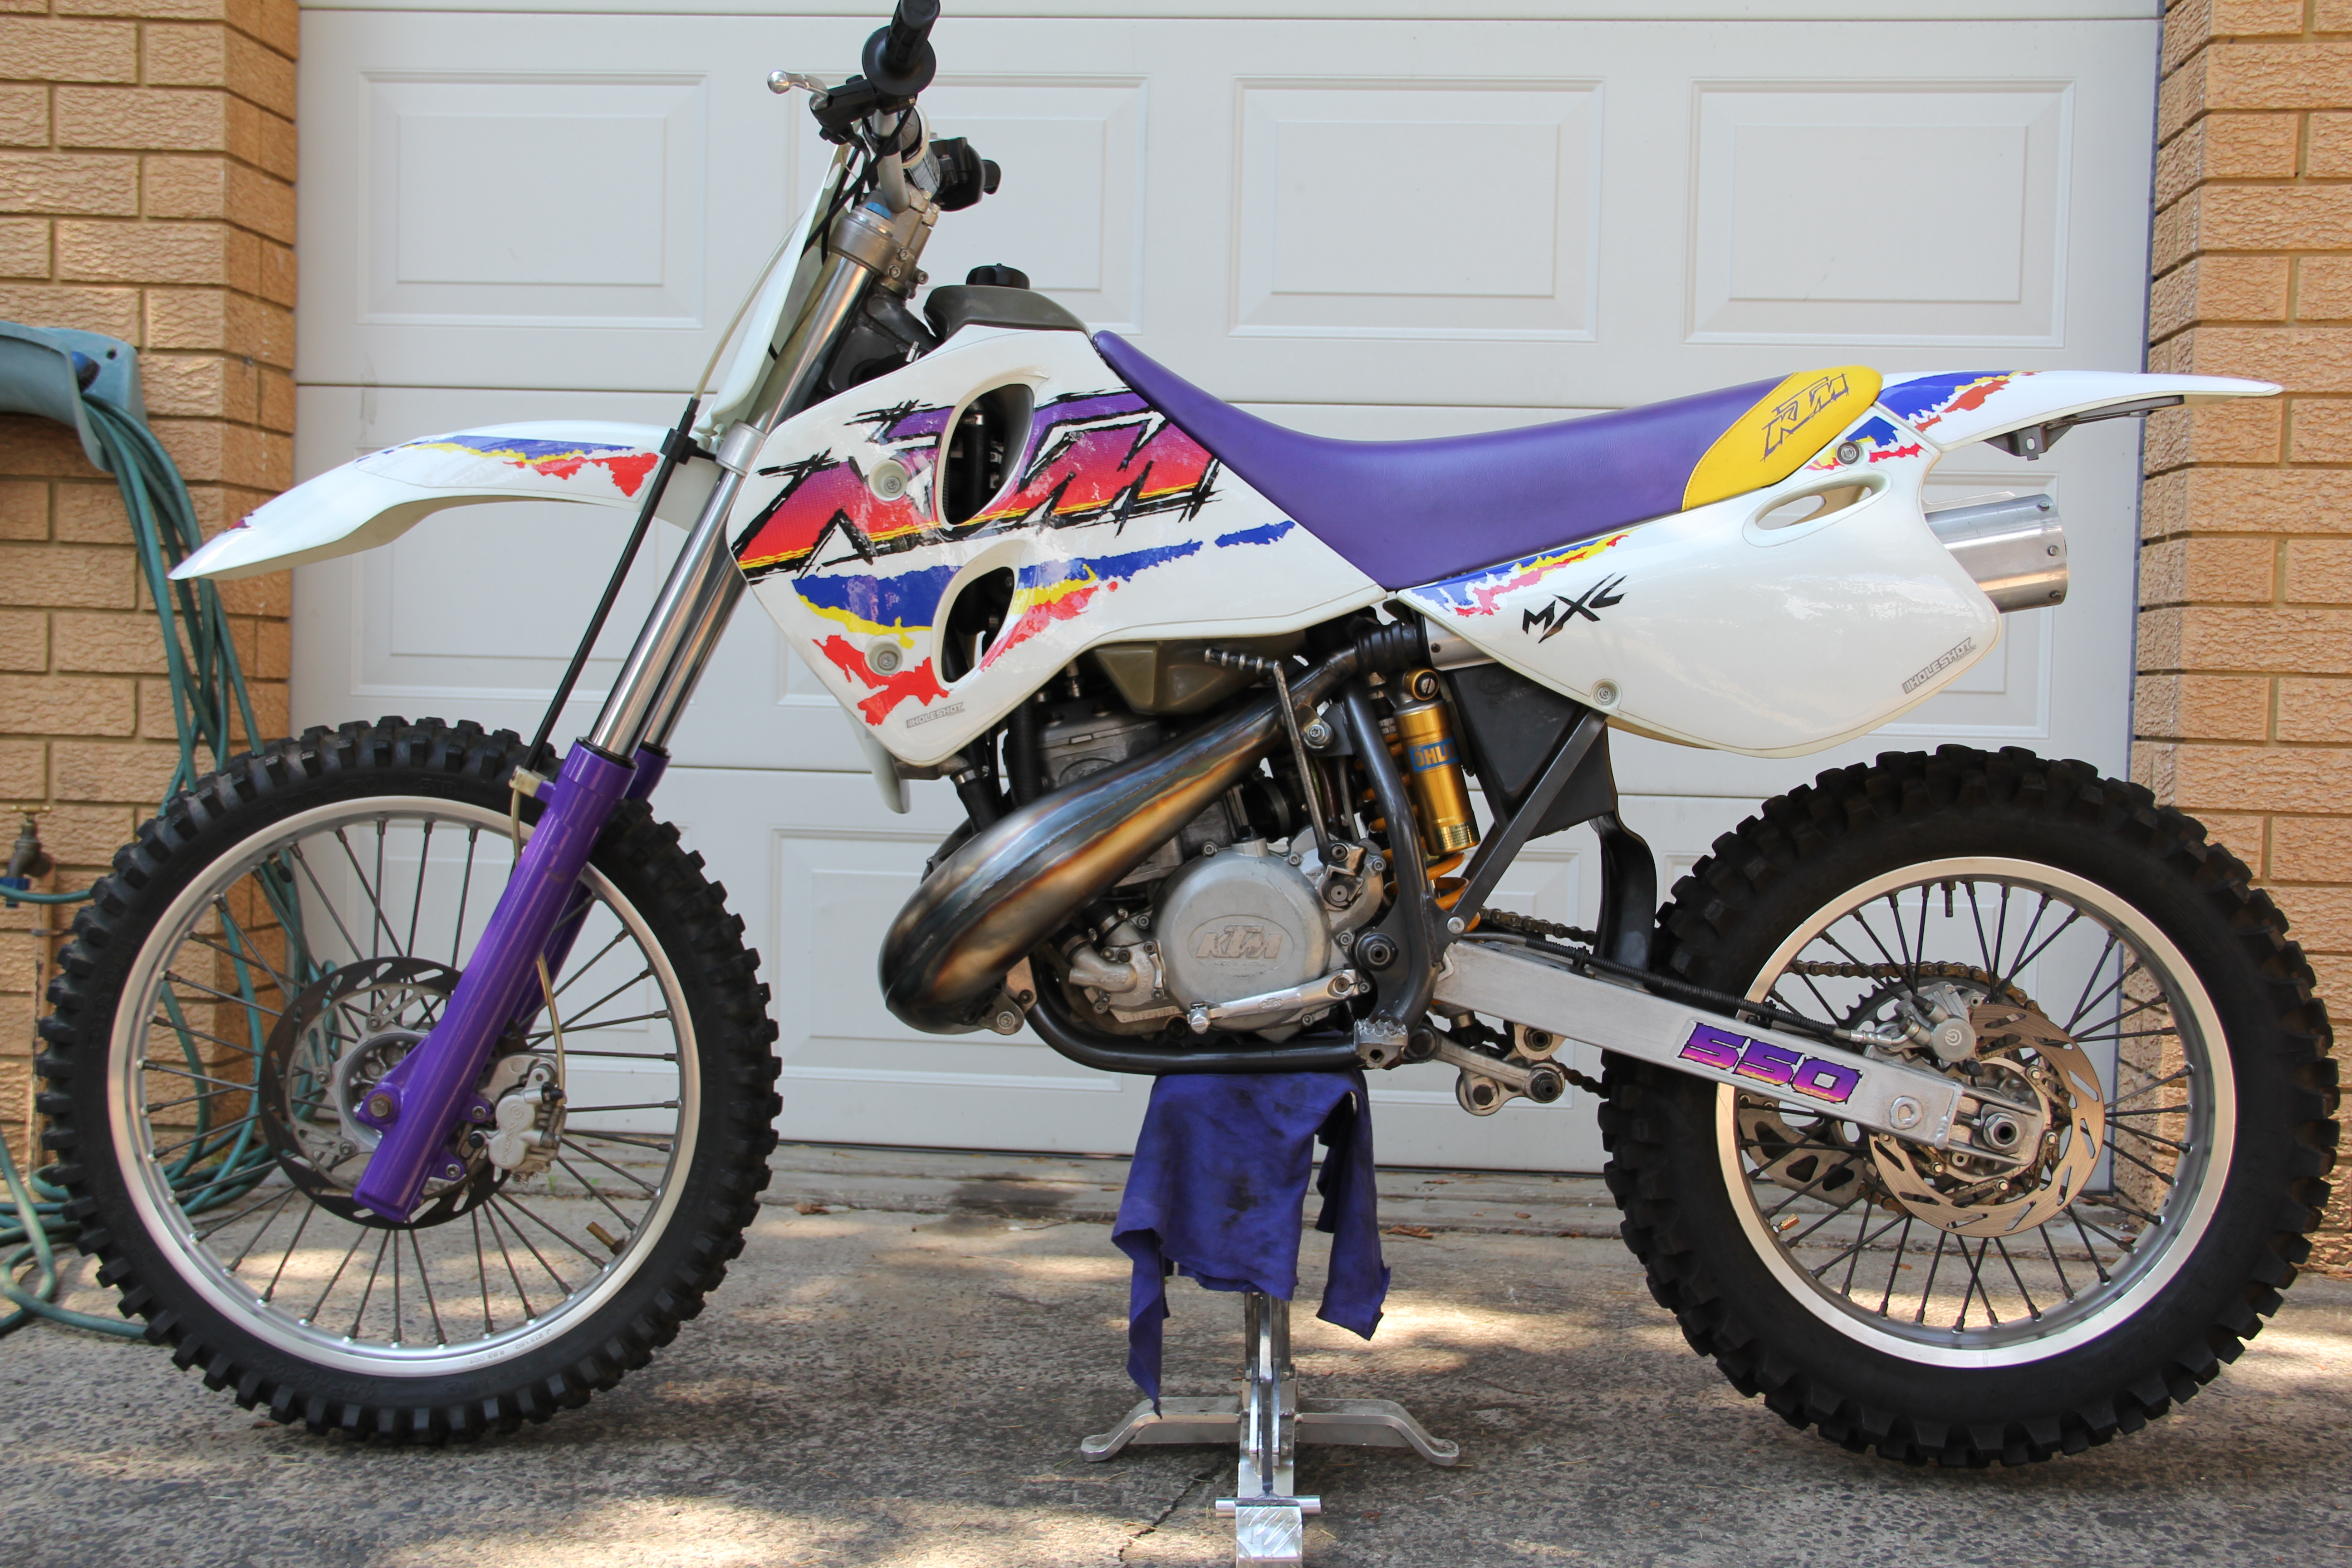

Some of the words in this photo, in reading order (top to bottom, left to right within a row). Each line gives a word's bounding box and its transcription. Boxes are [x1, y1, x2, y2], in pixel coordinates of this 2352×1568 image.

[1760, 372, 1849, 463] KTM
[1522, 572, 1628, 643] MXC
[1902, 637, 1971, 695] HOLESHOT
[906, 702, 964, 729] HOLESHOT
[1196, 924, 1282, 959] KTM
[1099, 974, 1127, 983] KTM
[1677, 1022, 1863, 1105] 550
